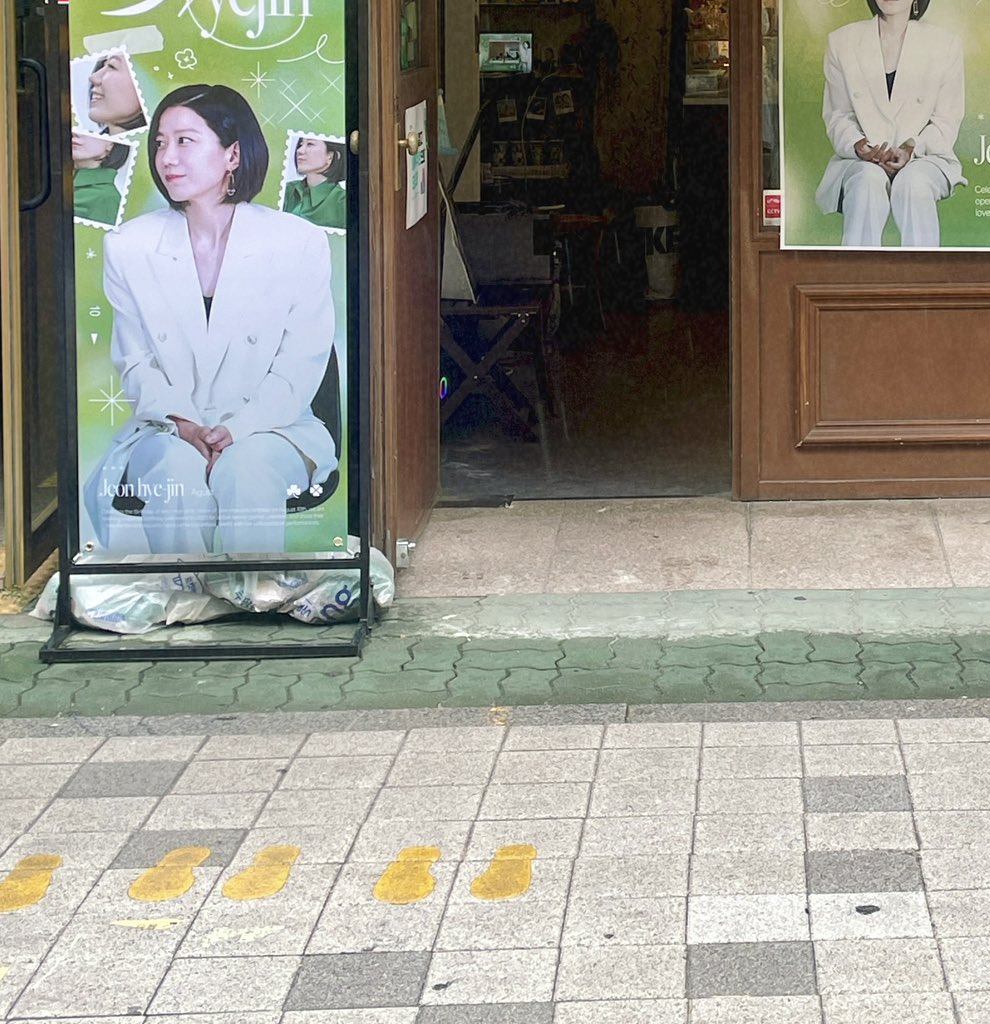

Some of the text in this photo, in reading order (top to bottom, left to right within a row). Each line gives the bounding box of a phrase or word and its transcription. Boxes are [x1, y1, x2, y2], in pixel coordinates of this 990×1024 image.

[89, 305, 101, 317] 10
[97, 477, 134, 497] Jeon
[137, 476, 185, 504] hye-jin
